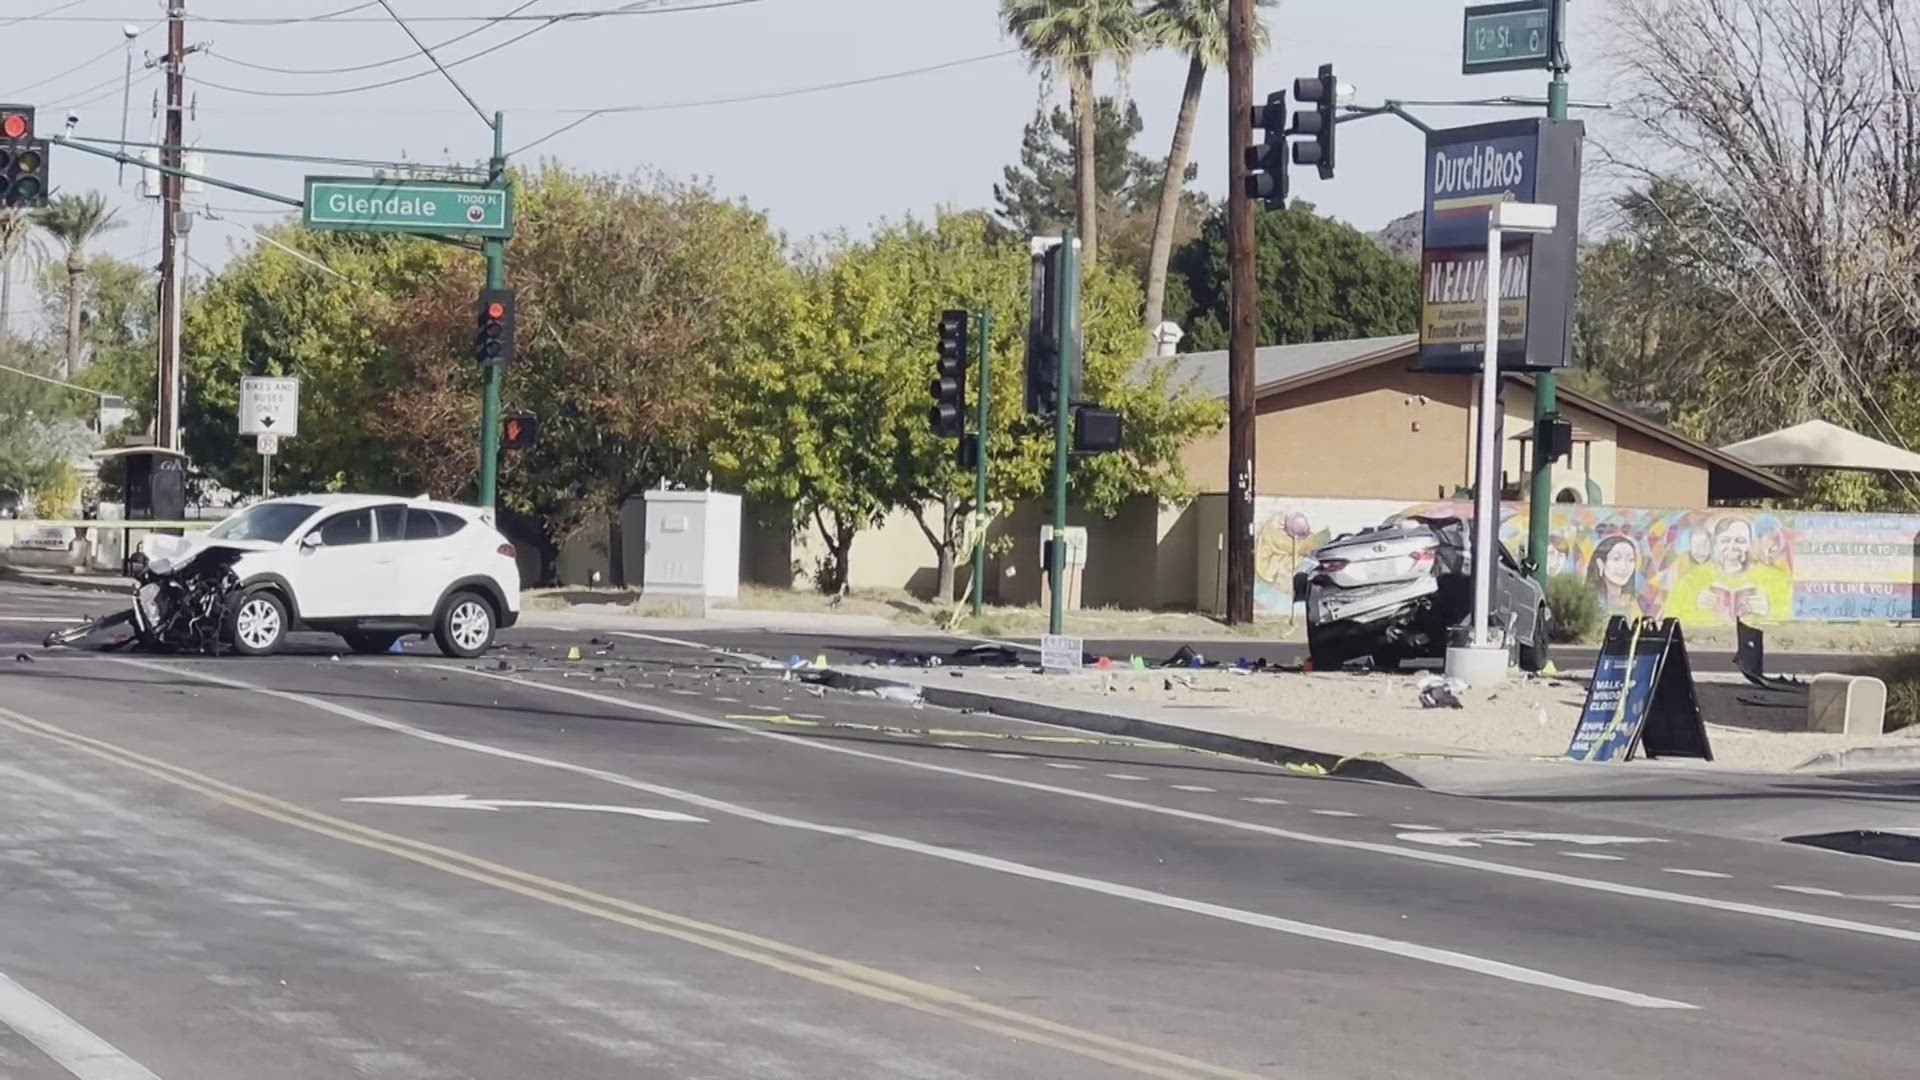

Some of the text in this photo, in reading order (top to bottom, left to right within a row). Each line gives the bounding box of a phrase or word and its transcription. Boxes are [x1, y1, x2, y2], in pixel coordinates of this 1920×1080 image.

[1497, 25, 1514, 49] St.
[1482, 146, 1523, 188] BROS
[329, 194, 437, 217] Glendale
[456, 193, 497, 206] 7000 N
[1428, 259, 1484, 302] KELLY
[245, 382, 294, 392] BIKES AND
[254, 393, 285, 402] BUSES
[256, 404, 280, 413] ONLY
[1802, 541, 1841, 553] SPEAK
[1847, 544, 1872, 555] LIKE
[1805, 582, 1894, 595] VOTE LIKE YOU
[1596, 680, 1637, 690] WALK-P
[1589, 701, 1618, 711] CLOSE
